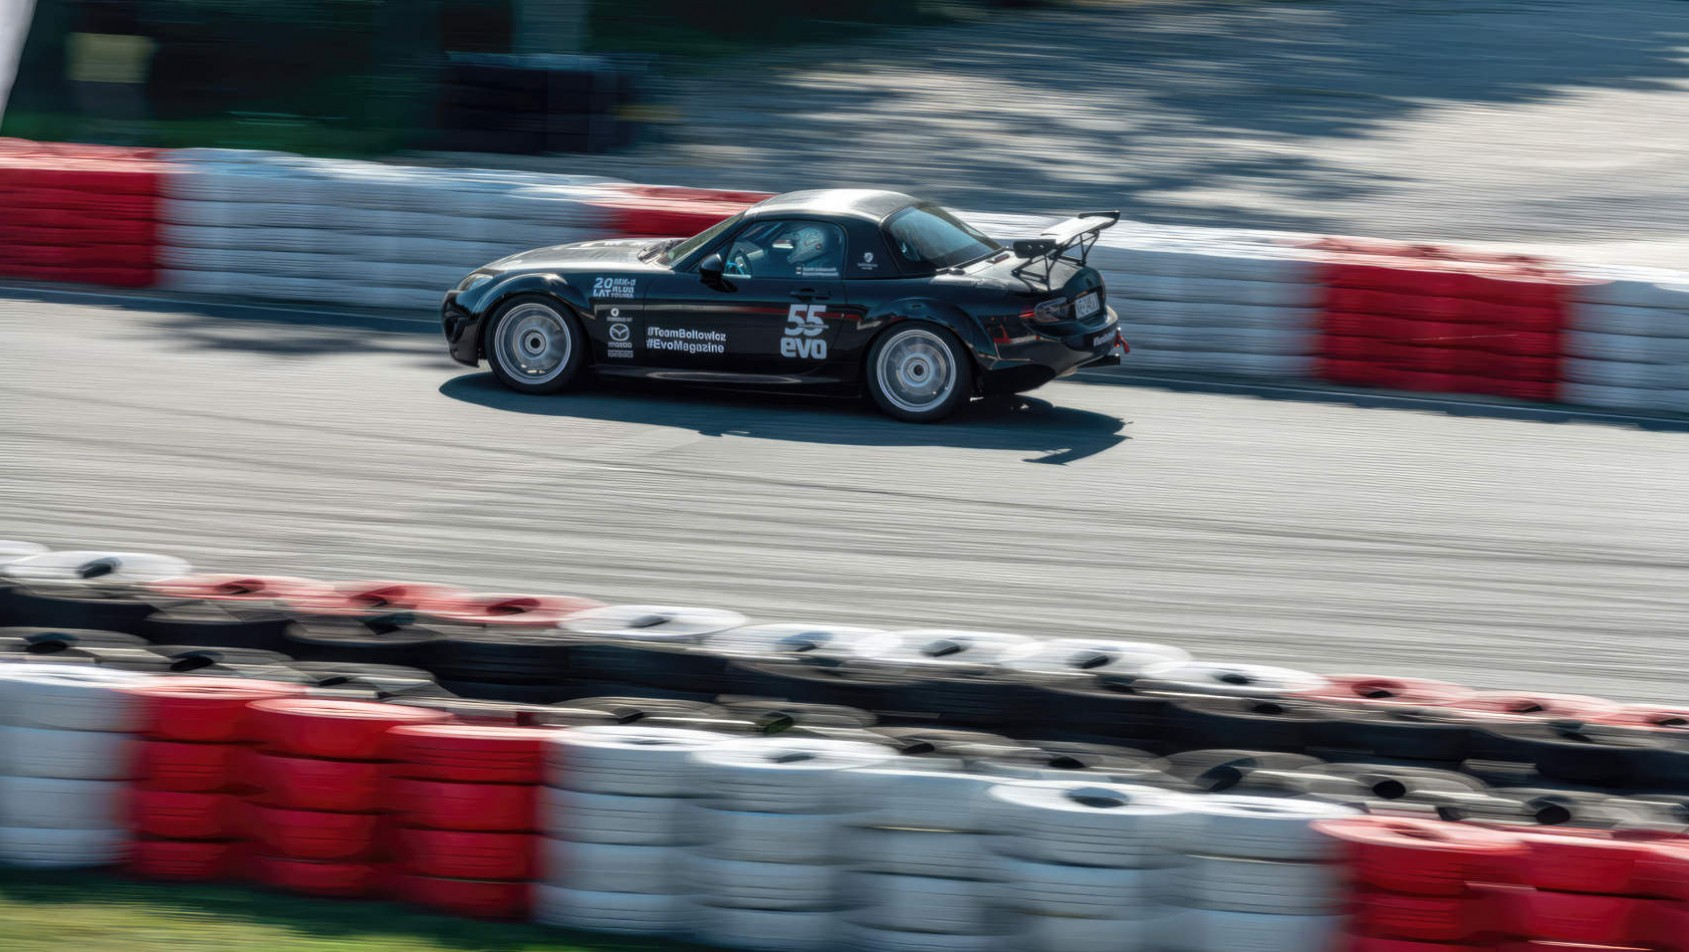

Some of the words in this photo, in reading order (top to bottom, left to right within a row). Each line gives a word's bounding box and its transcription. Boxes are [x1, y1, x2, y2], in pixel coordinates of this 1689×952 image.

[593, 277, 613, 289] 20
[592, 289, 611, 297] LAT
[785, 304, 827, 337] 55
[646, 338, 725, 354] #EvoMagazine
[780, 337, 827, 359] evo
